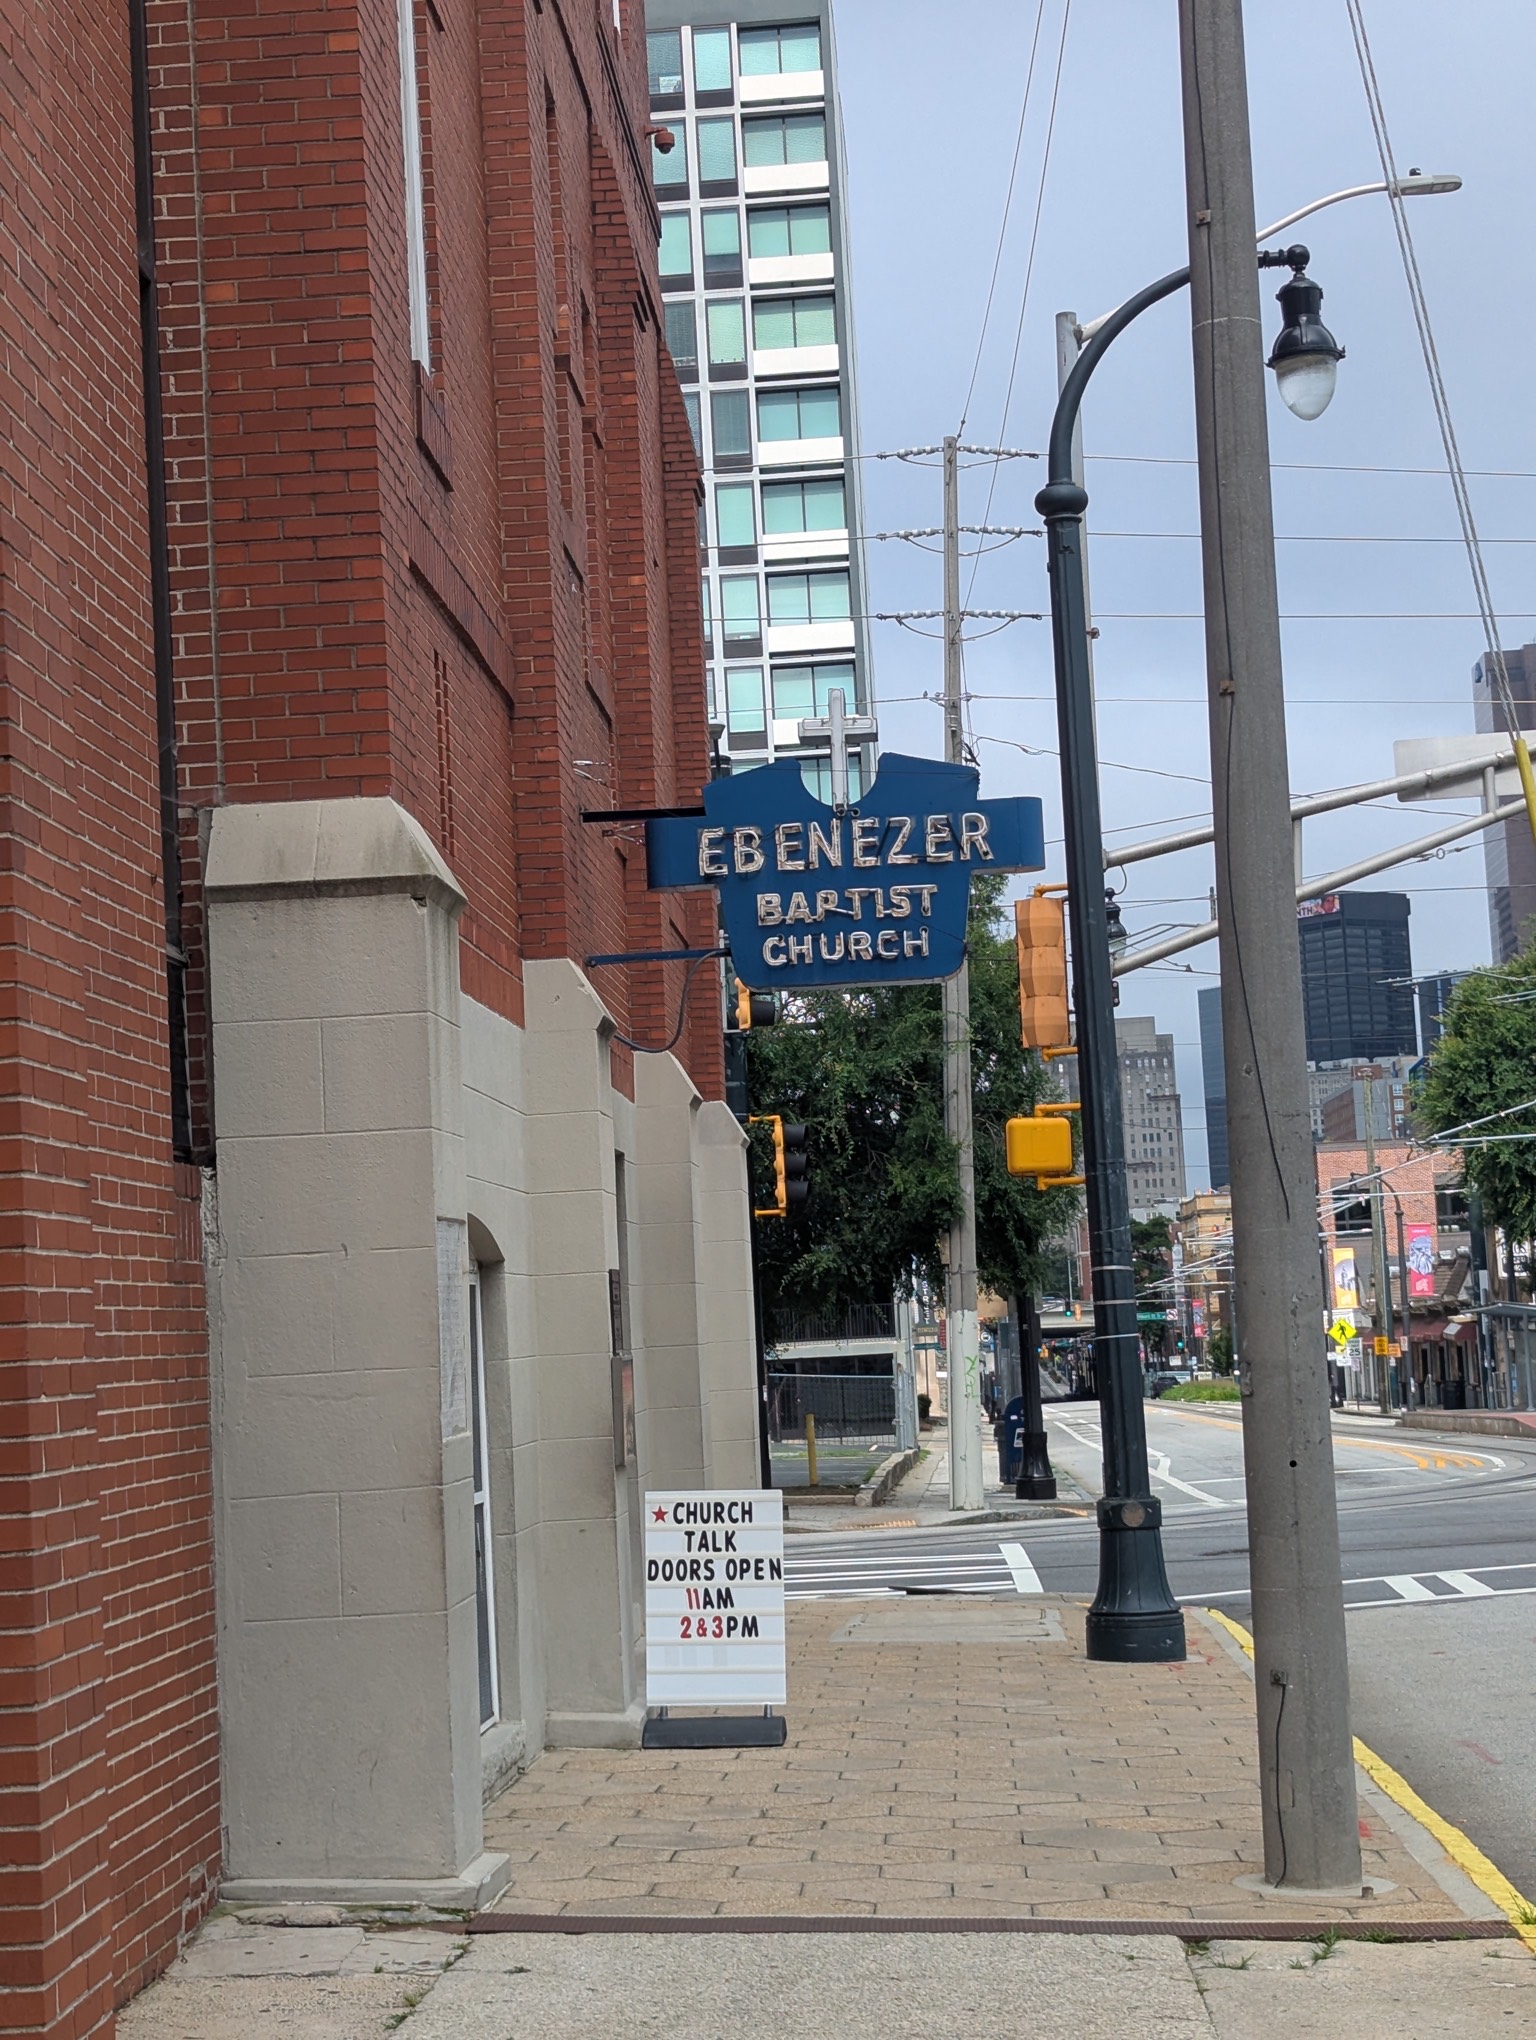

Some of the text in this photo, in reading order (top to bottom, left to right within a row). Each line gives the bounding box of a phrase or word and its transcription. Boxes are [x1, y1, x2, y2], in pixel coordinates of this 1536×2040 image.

[698, 812, 995, 877] EBENEZER
[757, 884, 939, 927] BAPTIST
[762, 927, 930, 967] CHURCH
[1349, 1348, 1361, 1356] 25
[673, 1501, 753, 1525] CHURCH
[684, 1530, 737, 1553] TALK
[647, 1558, 782, 1582] DOORS OPEN
[686, 1587, 735, 1610] 11AM
